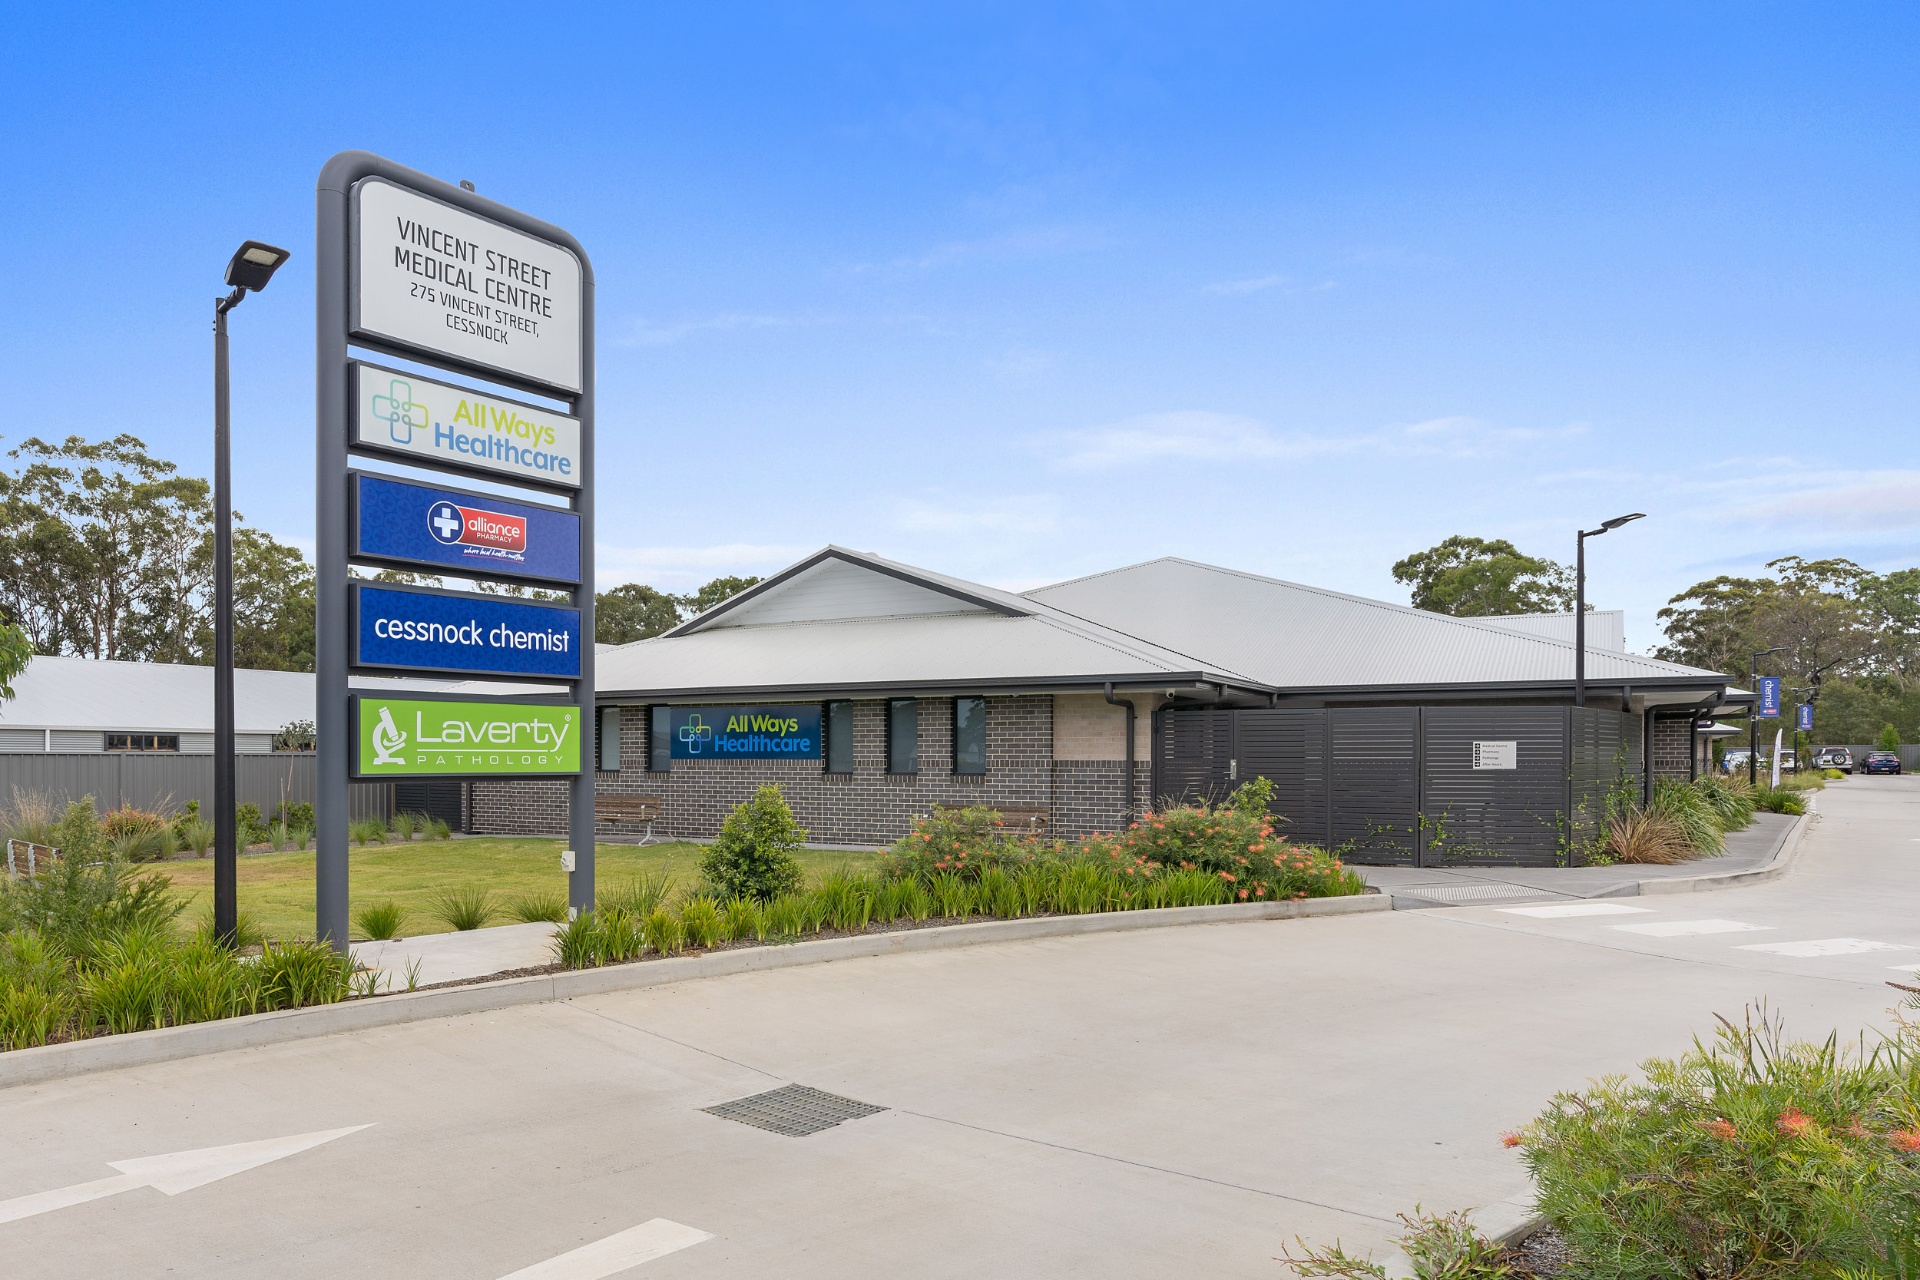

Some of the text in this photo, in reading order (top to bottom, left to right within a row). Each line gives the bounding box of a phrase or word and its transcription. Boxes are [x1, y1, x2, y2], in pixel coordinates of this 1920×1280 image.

[397, 216, 551, 291] VINCENT STREET
[395, 246, 552, 319] MEDICAL CENTRE
[410, 282, 539, 338] 275 VINCENT STREET,
[446, 313, 508, 345] CESSNOCK
[453, 399, 555, 448] All Ways
[434, 422, 572, 475] Healthcare
[468, 516, 520, 538] alliance
[476, 532, 512, 543] PHARMACY
[374, 618, 570, 652] cessnock chemist
[1765, 680, 1774, 708] chemist
[416, 710, 569, 752] Laverty
[726, 714, 799, 737] All Ways
[714, 734, 811, 752] Healthcare
[417, 755, 563, 765] PATHOLOGY
